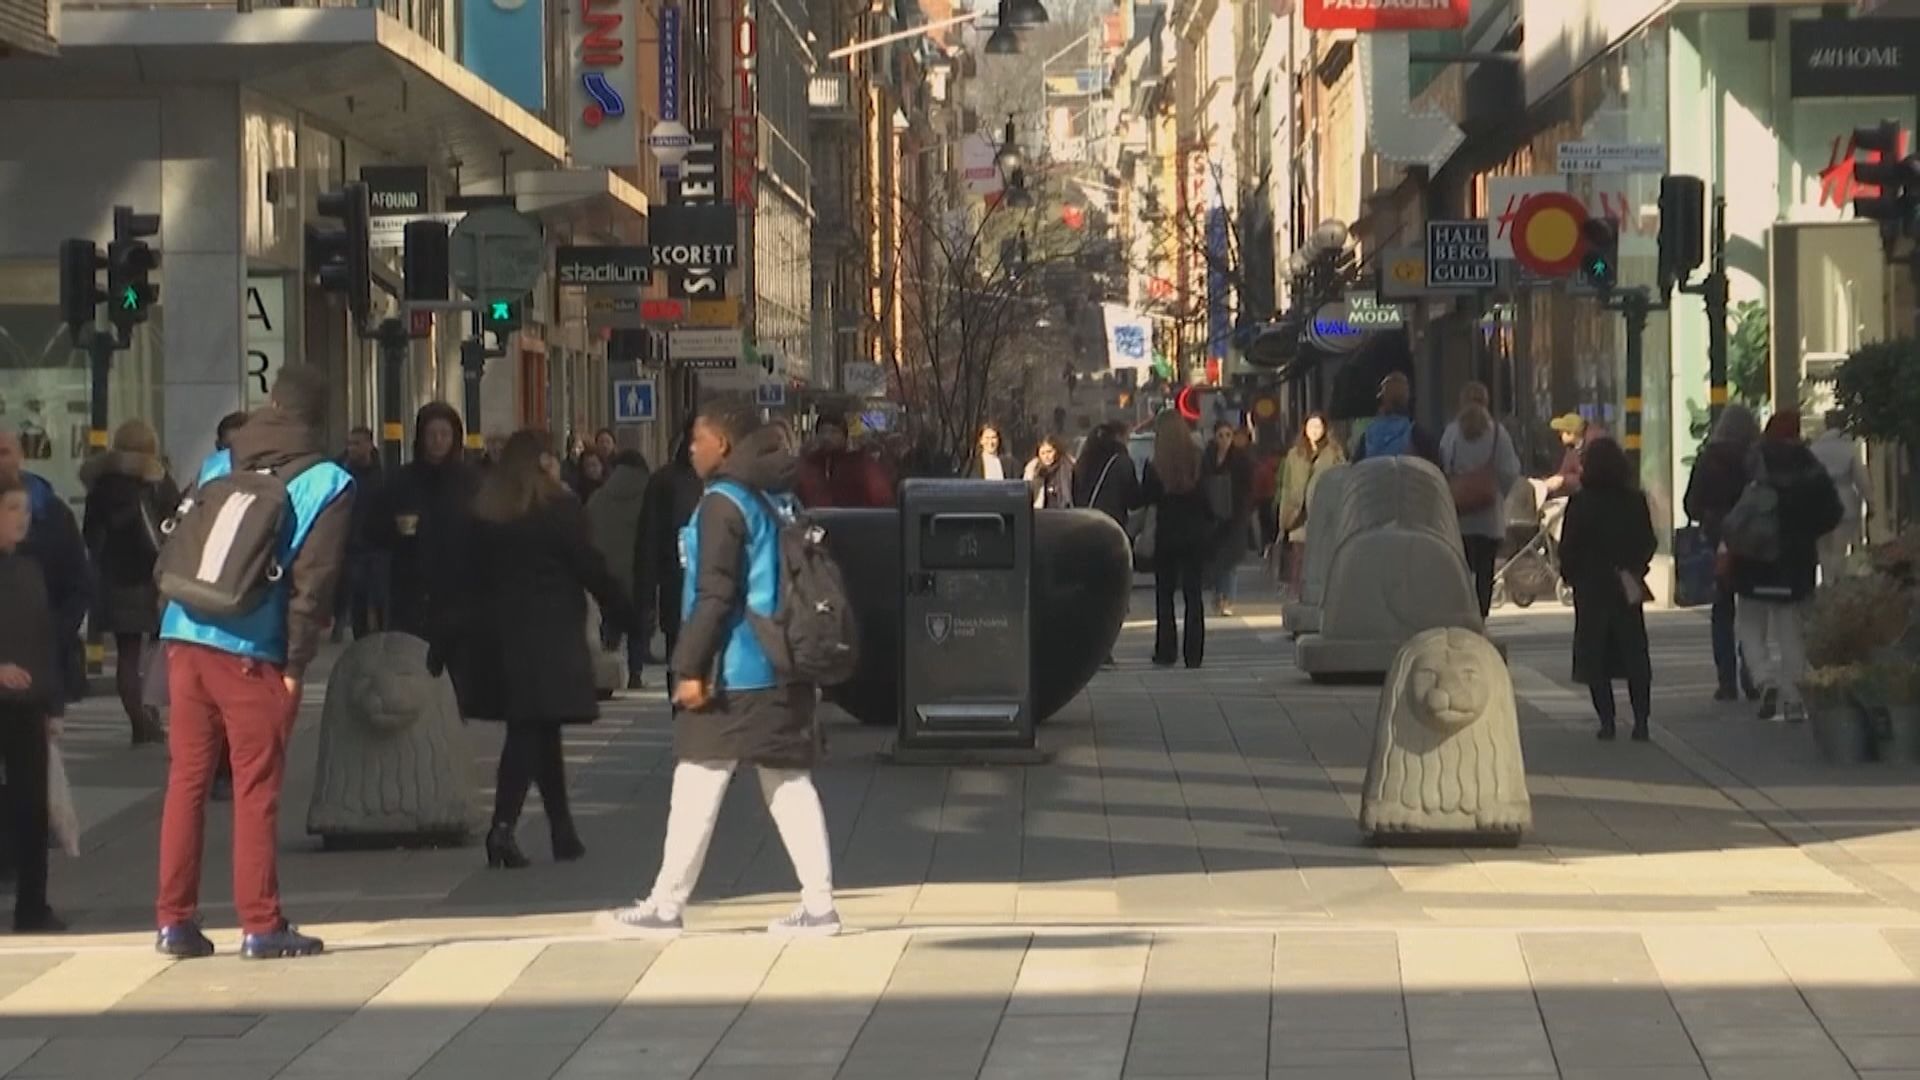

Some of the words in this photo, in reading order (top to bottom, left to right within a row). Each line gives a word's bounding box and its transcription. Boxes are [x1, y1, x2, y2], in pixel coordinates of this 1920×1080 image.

[1837, 47, 1903, 66] HOME
[371, 191, 418, 208] AFOUND
[1435, 226, 1484, 242] HALL
[652, 244, 735, 265] SCORETT
[1435, 244, 1487, 261] BERG
[560, 261, 649, 281] stadium
[1435, 264, 1489, 280] GULD
[1348, 309, 1400, 323] MODA
